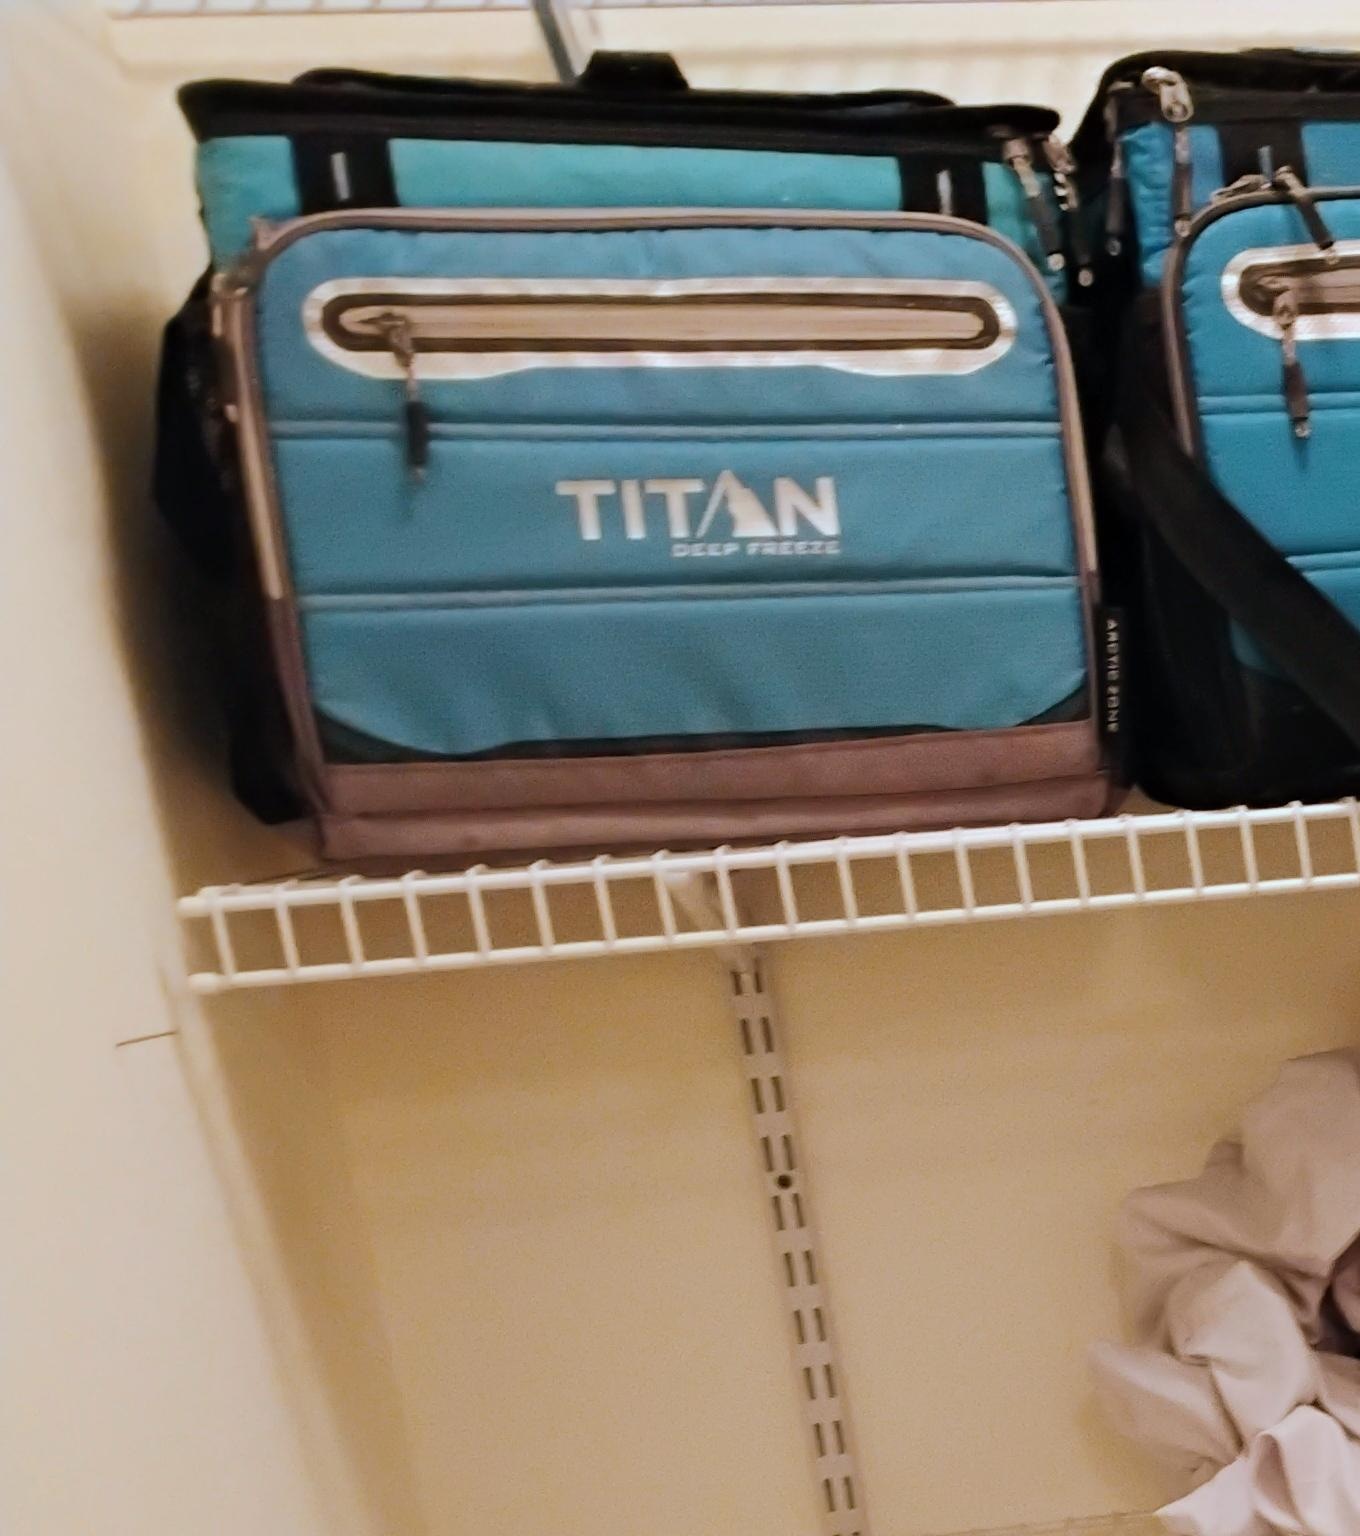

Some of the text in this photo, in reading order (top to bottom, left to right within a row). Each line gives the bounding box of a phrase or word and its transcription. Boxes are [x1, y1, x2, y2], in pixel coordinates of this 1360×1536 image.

[555, 468, 842, 541] TITAN
[672, 540, 841, 557] DEEP FREEZE
